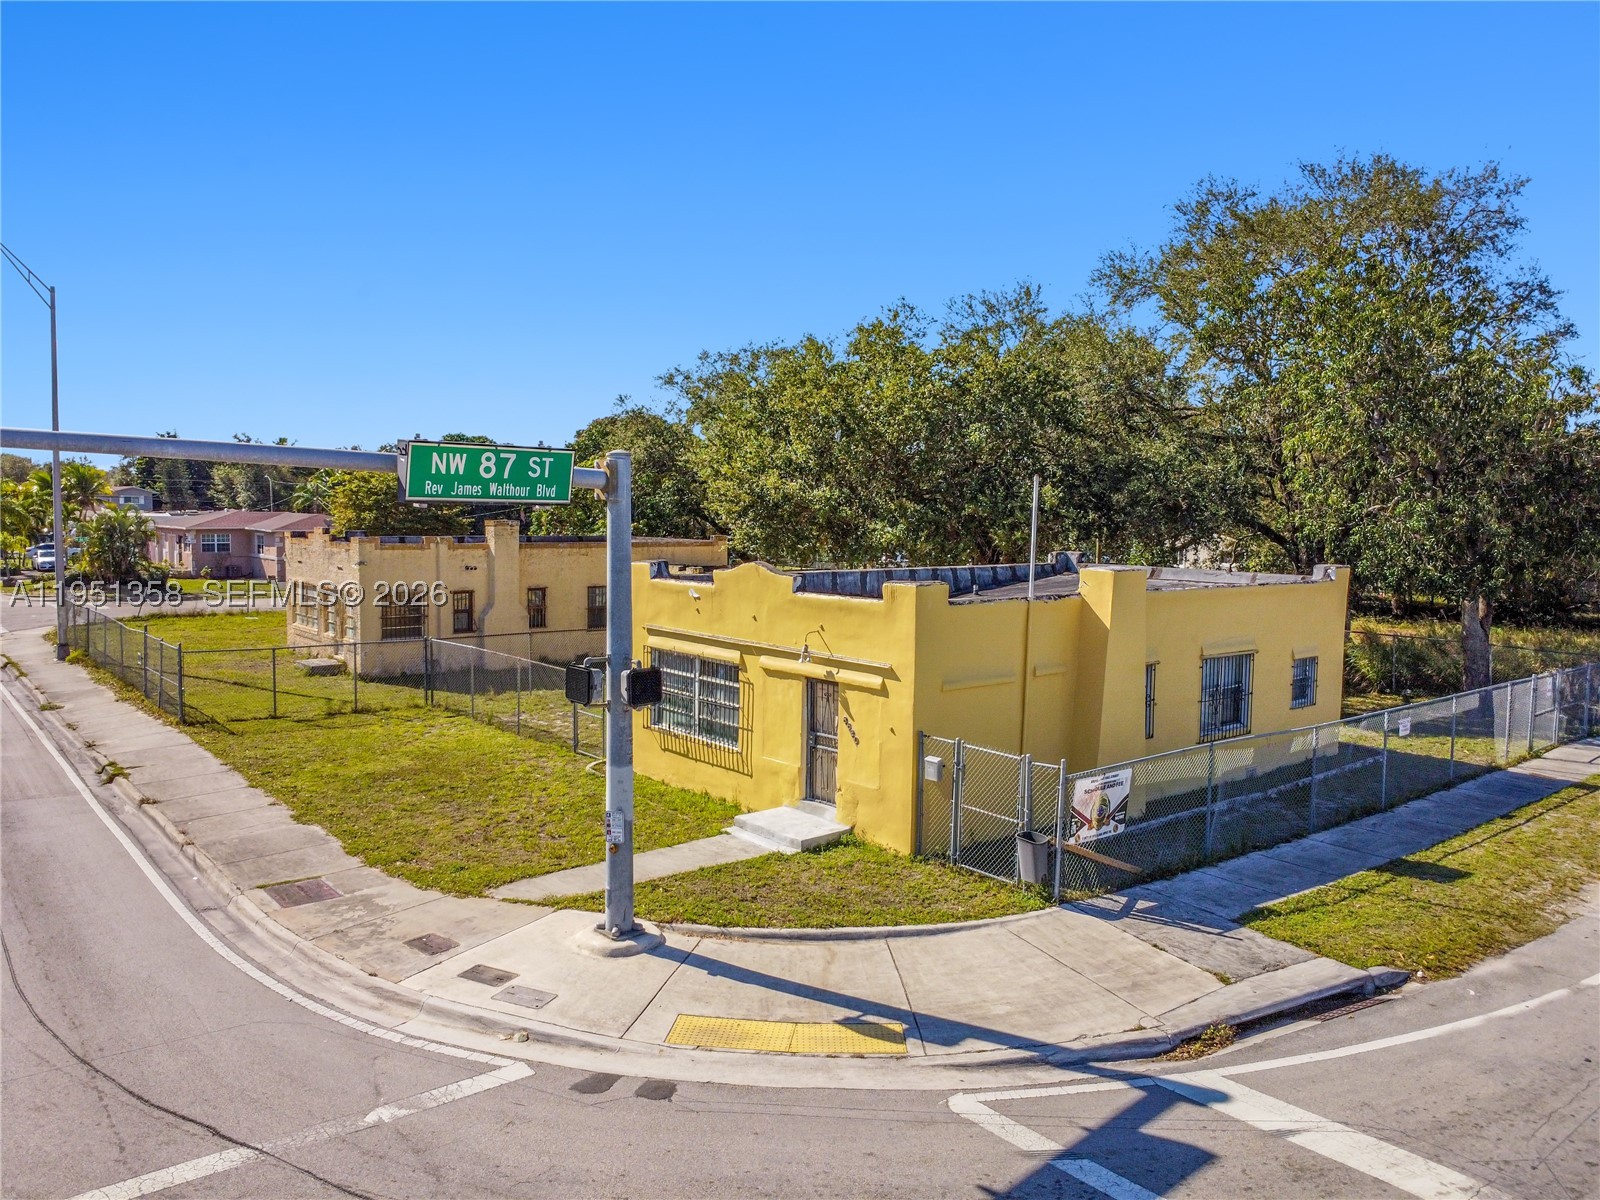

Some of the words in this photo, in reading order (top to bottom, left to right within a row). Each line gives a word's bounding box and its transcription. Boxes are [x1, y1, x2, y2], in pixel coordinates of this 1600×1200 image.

[431, 452, 467, 475] NW
[479, 452, 517, 479] 87
[528, 457, 554, 478] ST
[425, 481, 443, 495] Rev
[451, 481, 482, 496] James
[489, 482, 531, 497] Walthour
[536, 484, 556, 498] Blvd
